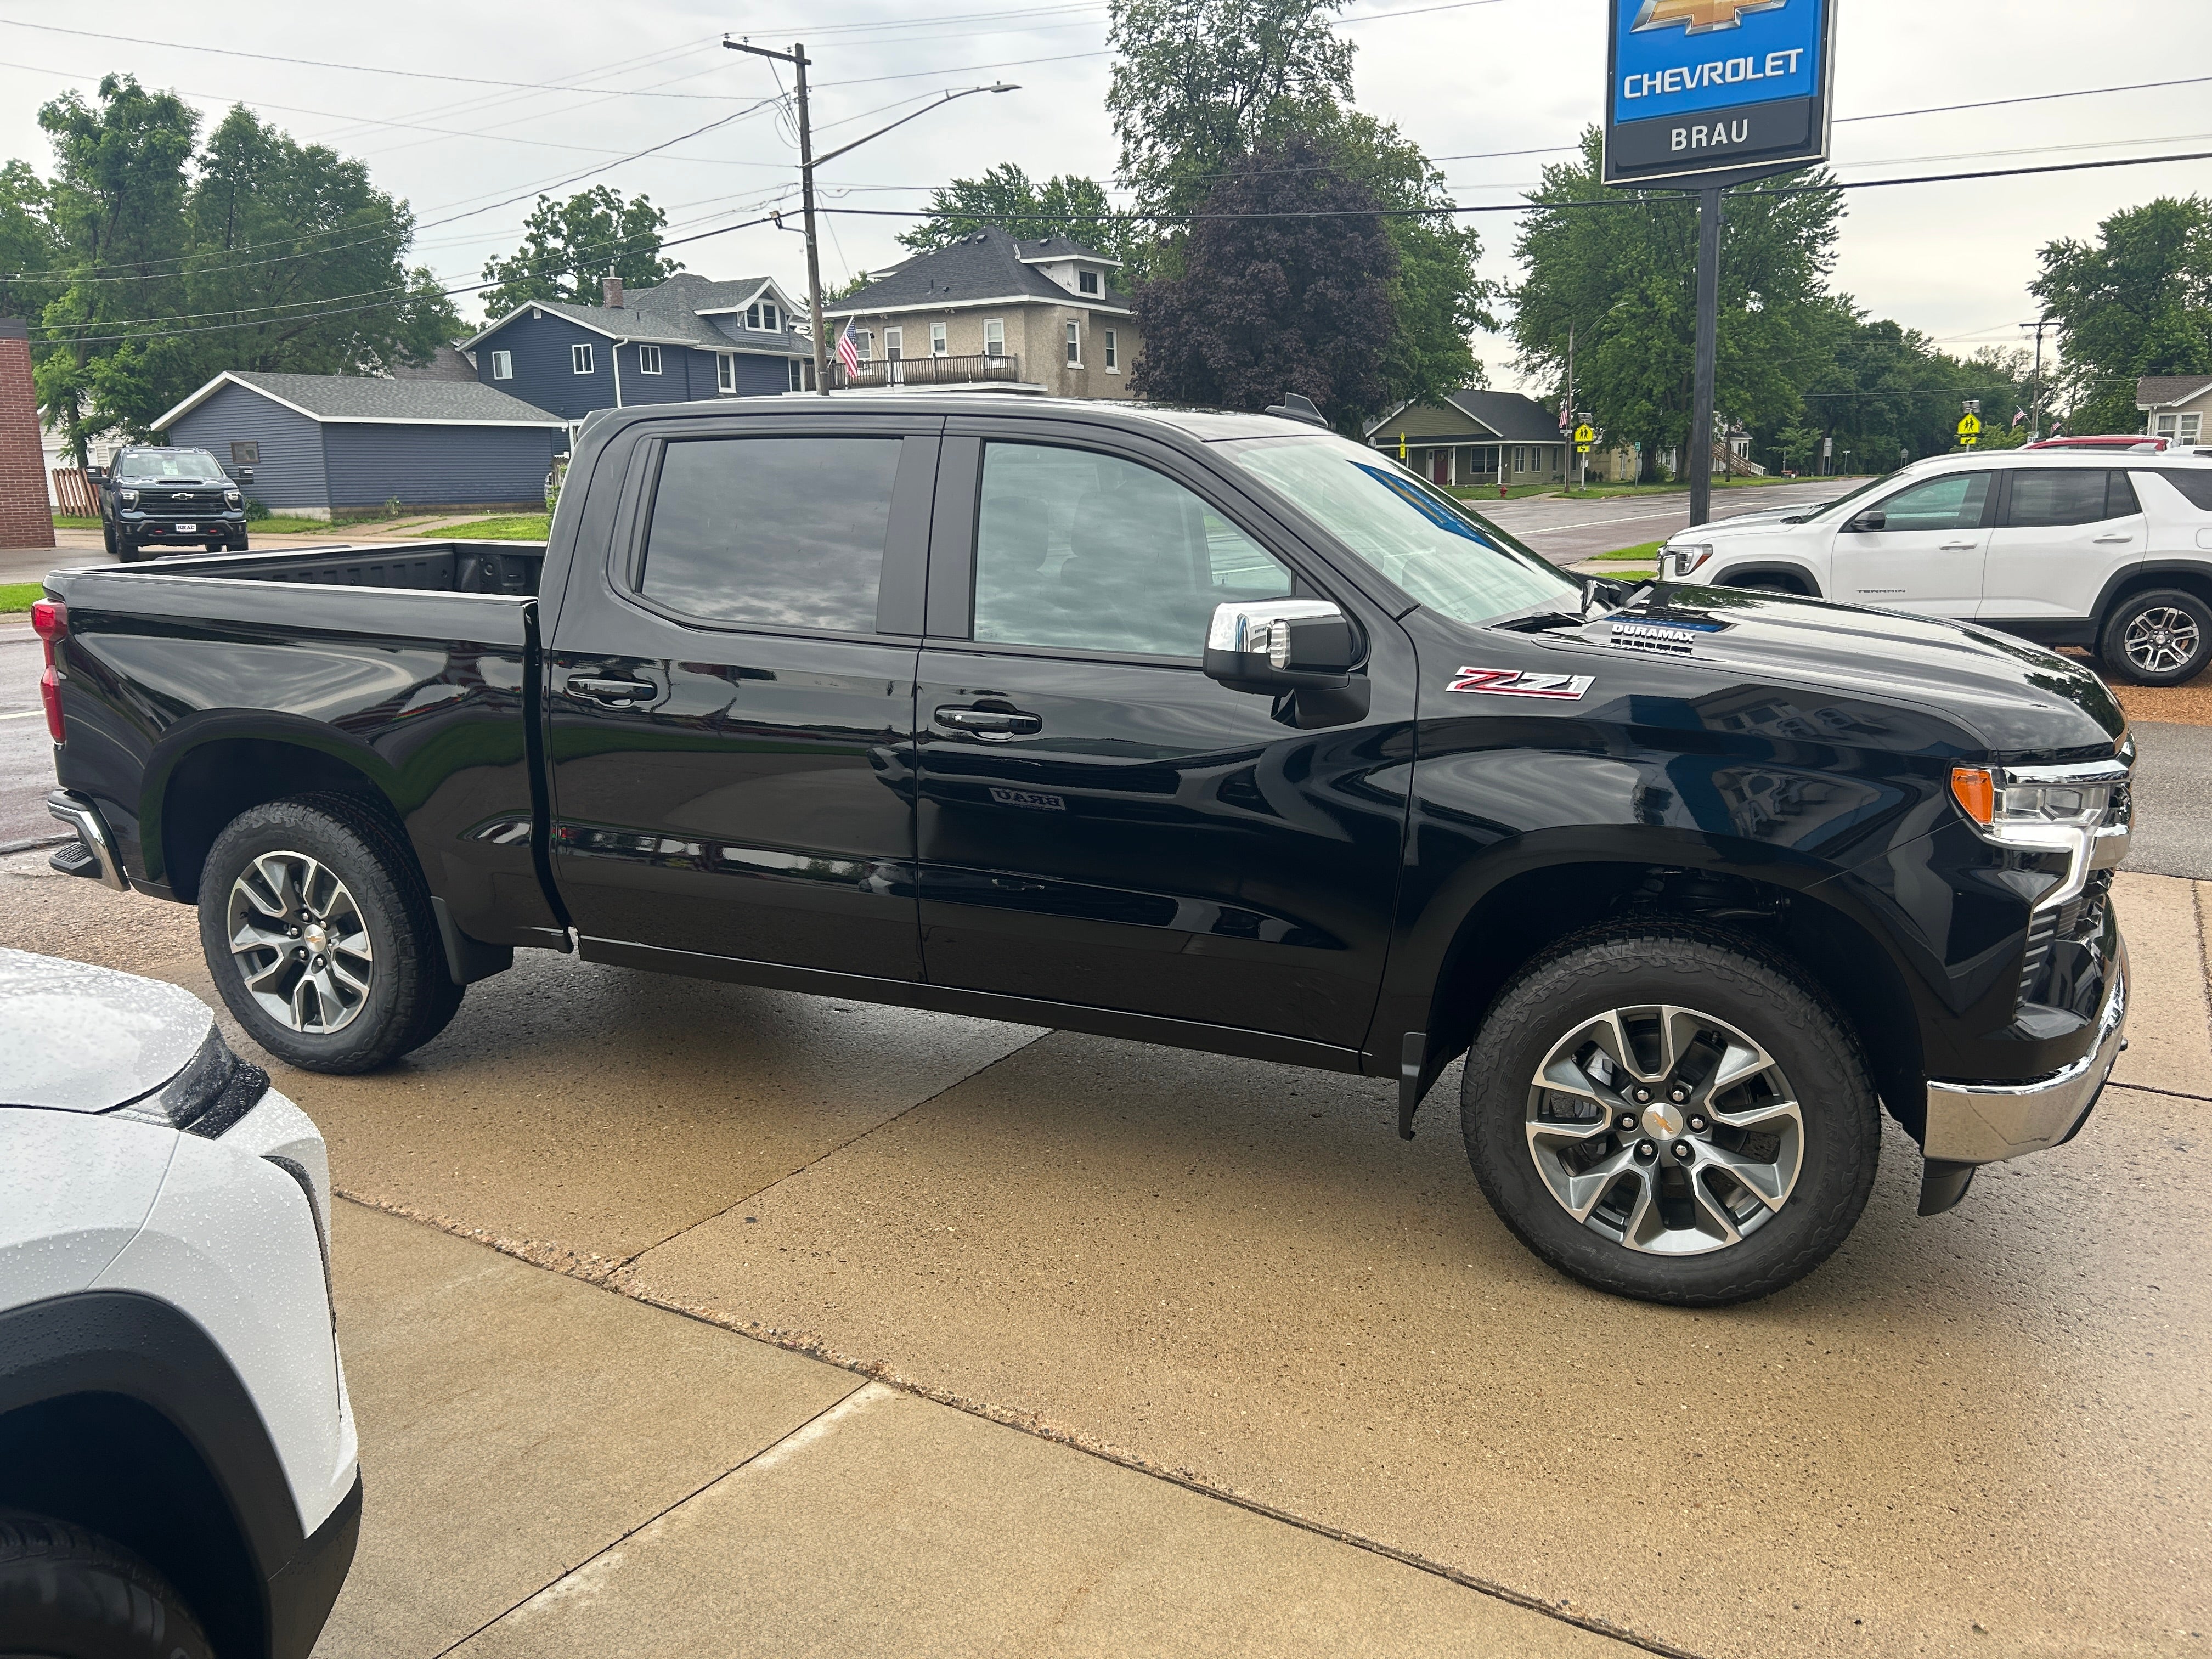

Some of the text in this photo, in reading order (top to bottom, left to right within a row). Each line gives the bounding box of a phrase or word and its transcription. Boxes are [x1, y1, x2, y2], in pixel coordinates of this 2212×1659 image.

[1624, 48, 1804, 99] CHEVROLET
[1671, 119, 1748, 151] BRAU
[1611, 624, 1695, 644] DURAMAX
[1446, 666, 1597, 701] Z71
[1492, 1013, 1549, 1142] DUELER
